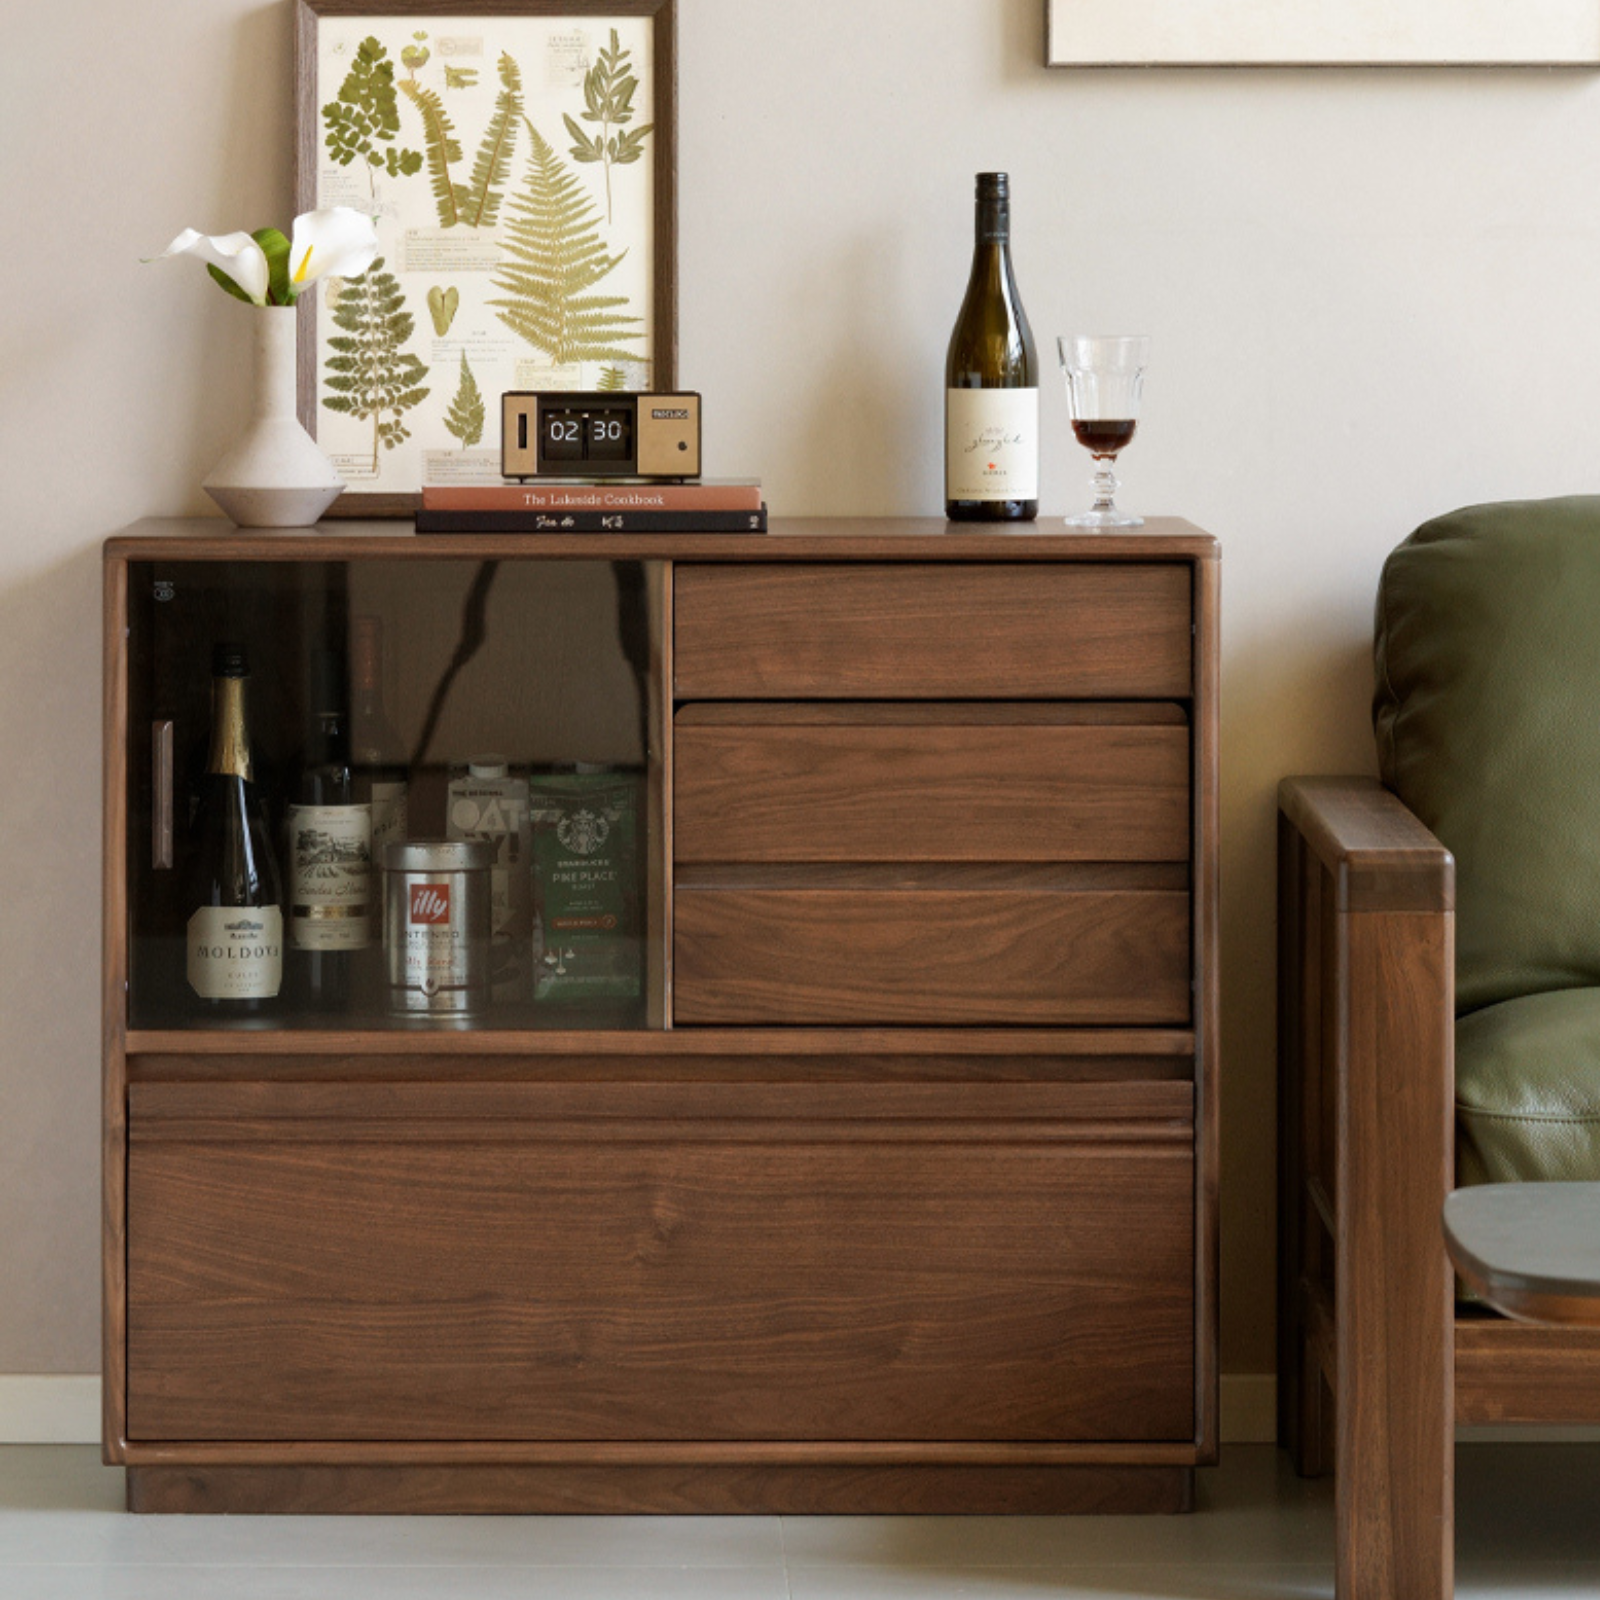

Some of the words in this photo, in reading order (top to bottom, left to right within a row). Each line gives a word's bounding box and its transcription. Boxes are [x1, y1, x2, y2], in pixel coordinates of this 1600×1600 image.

[550, 421, 580, 441] 02
[593, 421, 623, 441] 30
[523, 493, 546, 504] The
[550, 493, 601, 504] Lakeside
[604, 493, 664, 504] Cookbook
[552, 873, 576, 883] PIKE
[580, 871, 614, 882] PLACE
[413, 889, 447, 920] illy
